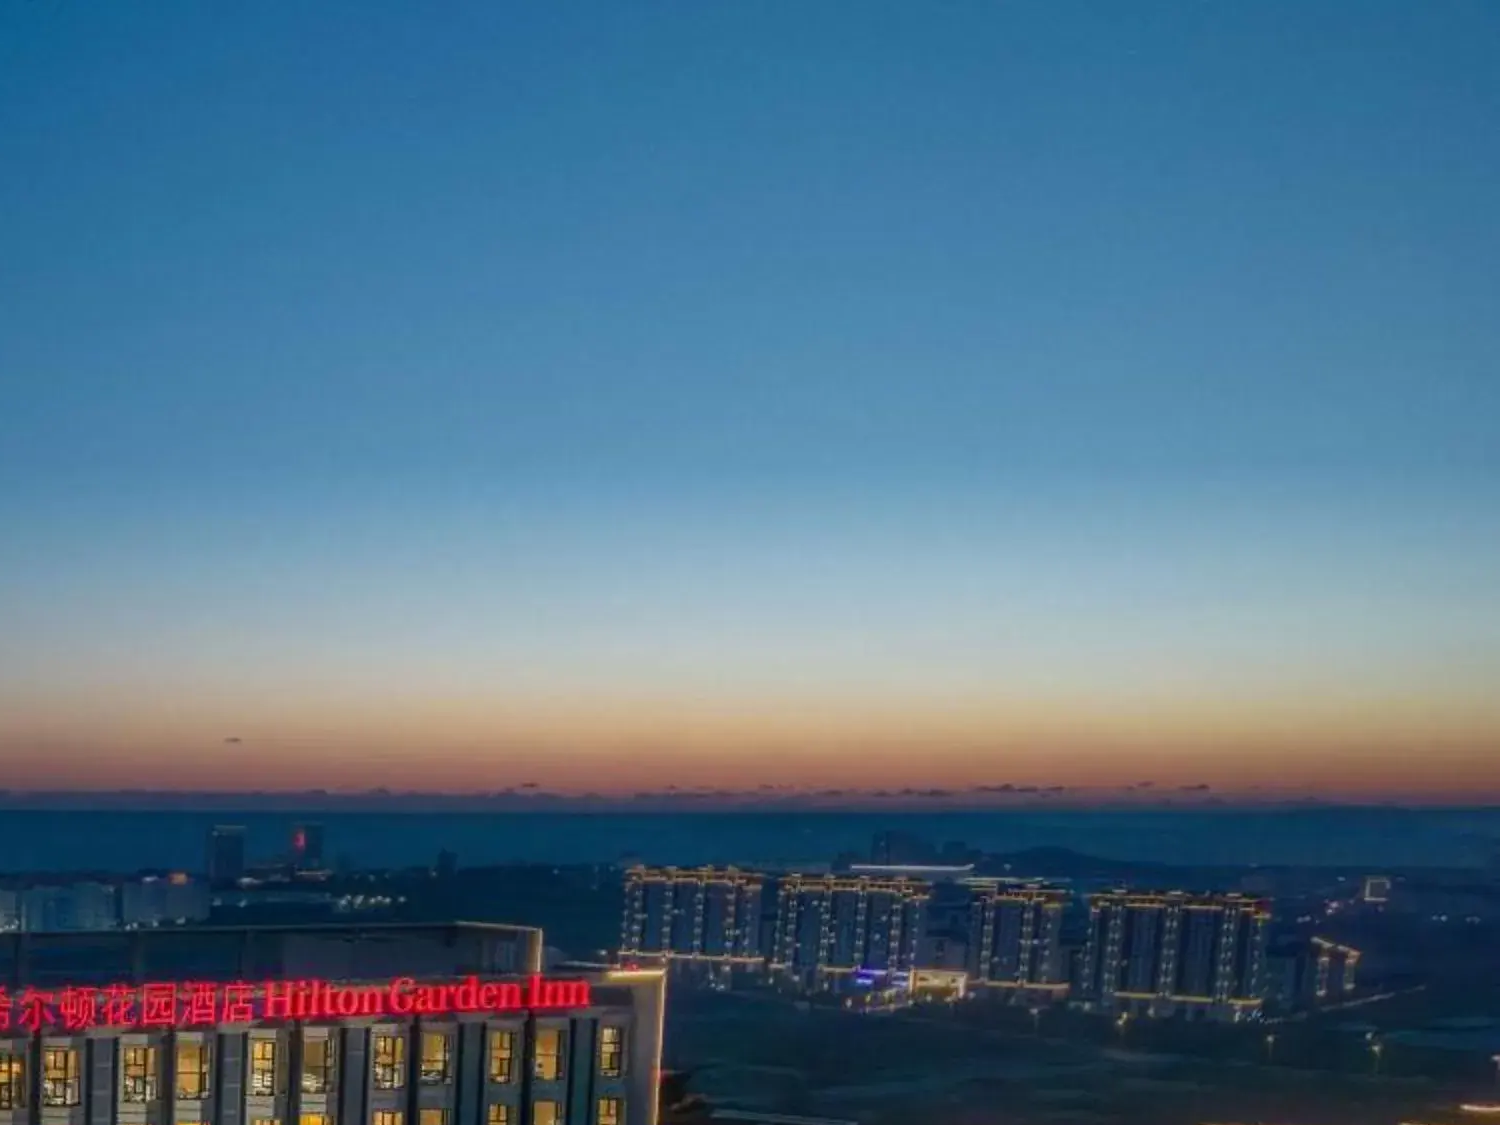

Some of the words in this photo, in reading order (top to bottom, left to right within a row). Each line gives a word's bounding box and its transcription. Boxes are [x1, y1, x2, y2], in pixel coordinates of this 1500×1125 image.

[265, 979, 383, 1018] Hilton
[389, 976, 521, 1012] Garden
[529, 974, 591, 1007] Inn
